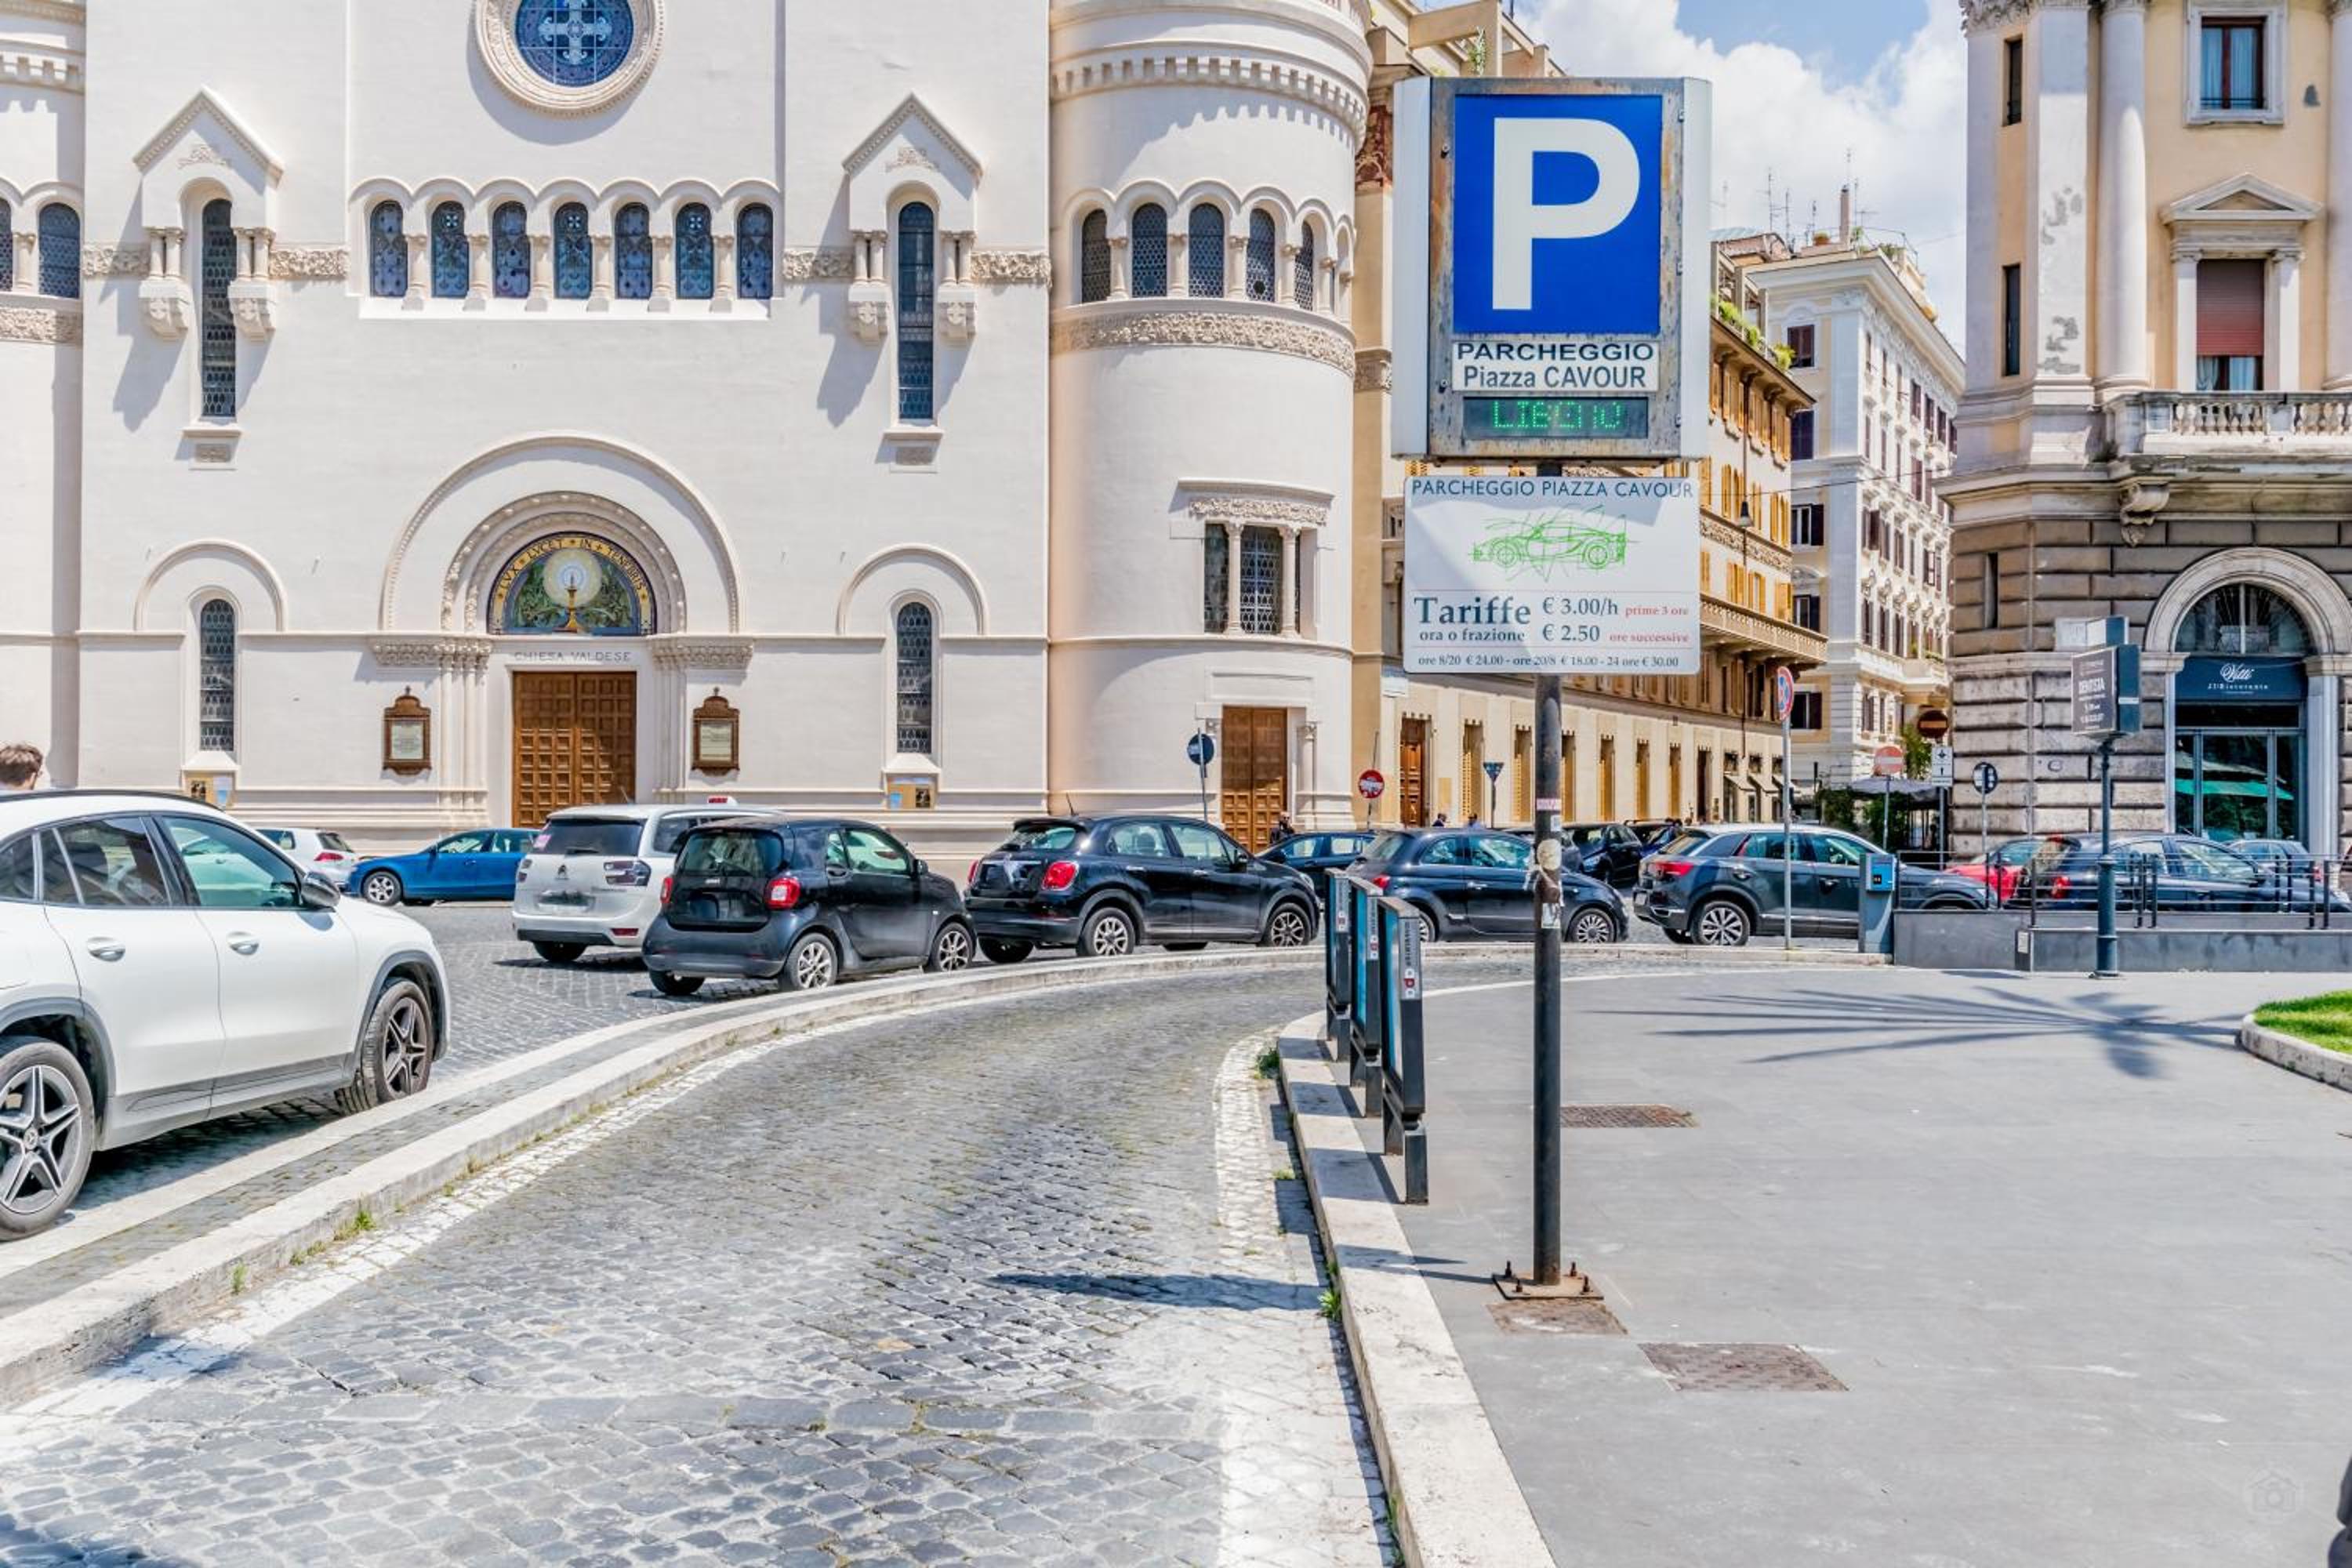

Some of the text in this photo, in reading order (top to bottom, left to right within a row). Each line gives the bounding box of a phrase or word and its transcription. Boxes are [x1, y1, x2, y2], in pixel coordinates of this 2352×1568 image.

[1493, 118, 1641, 310] P
[1457, 343, 1654, 361] PARCHEGGIO
[1464, 365, 1646, 389] Piazza CAVOUR
[1411, 480, 1693, 498] PARCHEGGIO PIAZZA CAVOUR
[1414, 596, 1531, 625] Tariffe
[1542, 597, 1555, 615] €
[1561, 597, 1618, 616] 3.00/h
[1625, 605, 1660, 619] prime
[1420, 630, 1443, 641] ora
[1448, 630, 1457, 641] o
[1462, 627, 1525, 641] frazione
[1542, 623, 1555, 642] €
[1561, 624, 1600, 642] 2.50
[571, 652, 632, 662] VALDESE
[1417, 657, 1436, 666] ore
[1439, 655, 1461, 666] 8/20
[1465, 655, 1474, 666] €
